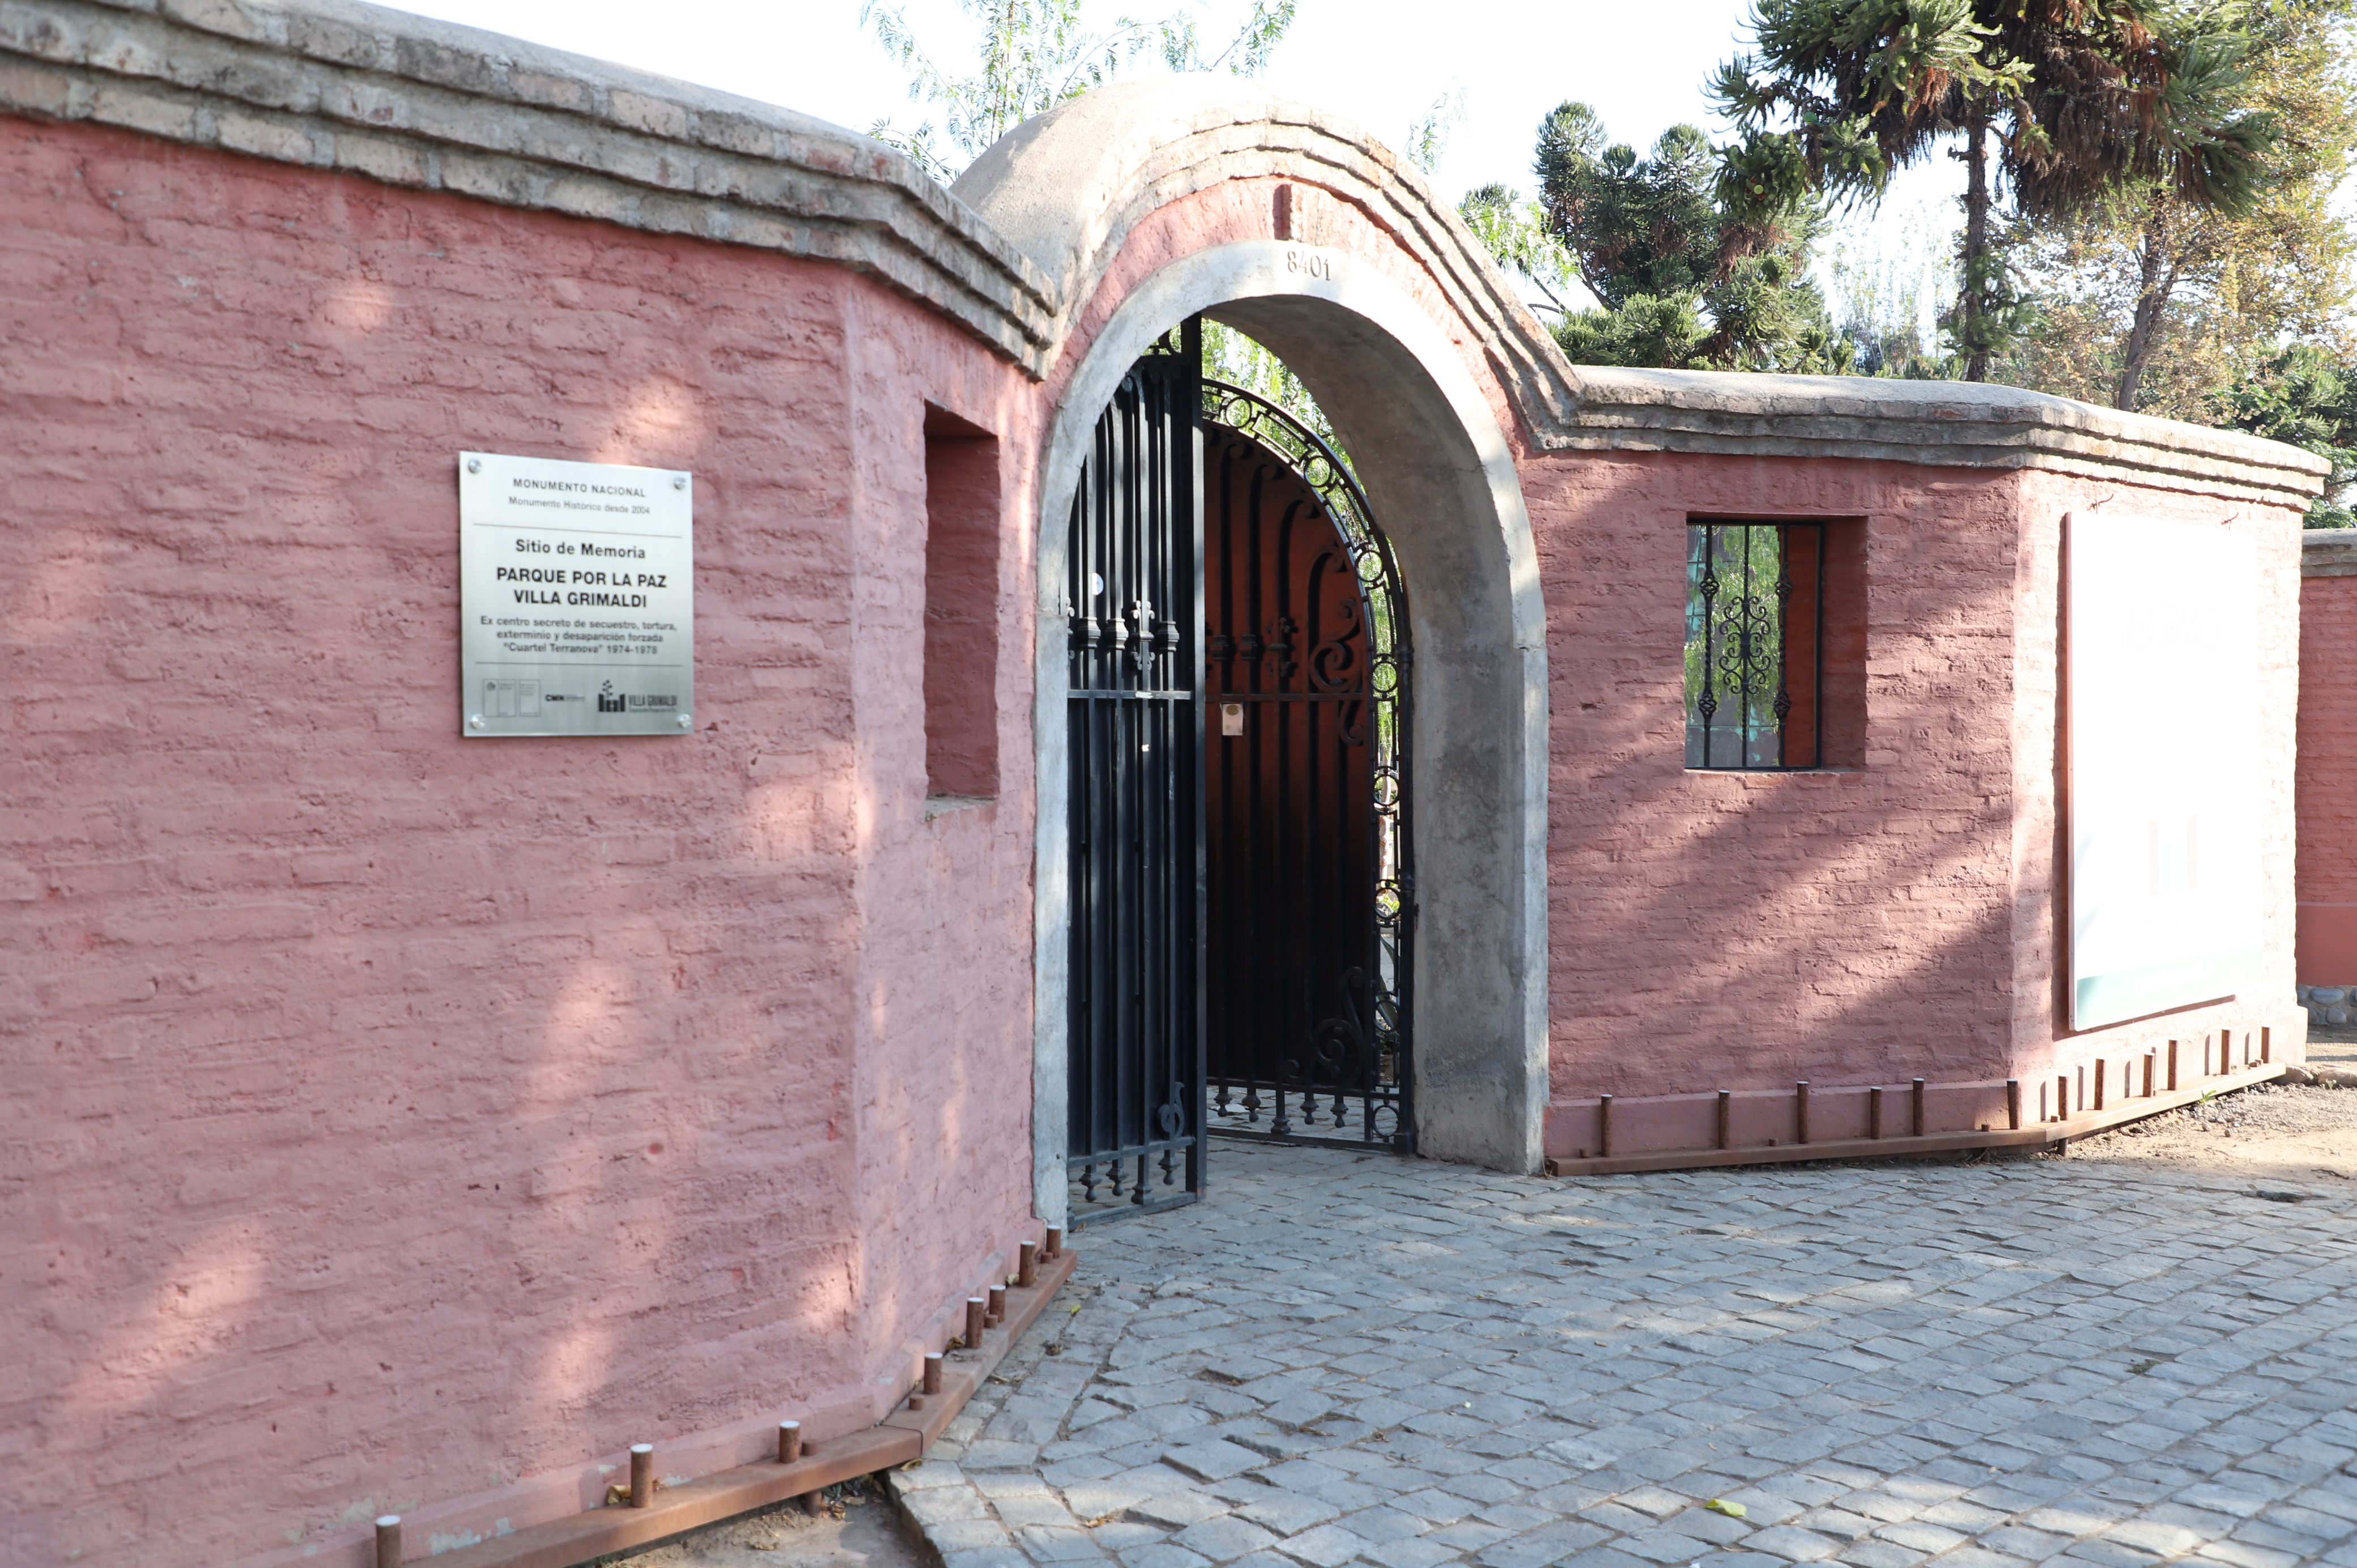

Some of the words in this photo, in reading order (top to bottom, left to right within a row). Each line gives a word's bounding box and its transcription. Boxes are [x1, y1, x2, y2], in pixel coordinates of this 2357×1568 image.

[1287, 250, 1331, 282] 8401
[513, 478, 588, 493] MONUMENTO
[592, 484, 646, 498] NACIONAL
[509, 496, 561, 508] Monumento
[605, 503, 629, 513] desde
[631, 505, 650, 514] 2004
[516, 539, 551, 553] Sitio
[556, 542, 575, 555] de
[581, 543, 646, 559] Memoria
[496, 566, 567, 583] PARQUE
[572, 570, 606, 585] POR
[612, 573, 632, 586] LA
[638, 574, 667, 588] PAZ
[514, 589, 561, 605] VILLA
[567, 592, 647, 608] GRIMALDI
[480, 615, 493, 625] Ex
[497, 617, 530, 626] centro
[534, 619, 571, 628] secreto
[575, 619, 587, 628] de
[590, 620, 639, 630] secuestro,
[643, 621, 677, 632] tortura,
[497, 630, 552, 640] exterminio
[554, 633, 559, 642] y
[563, 632, 625, 642] desaparición
[628, 633, 663, 642] forzada
